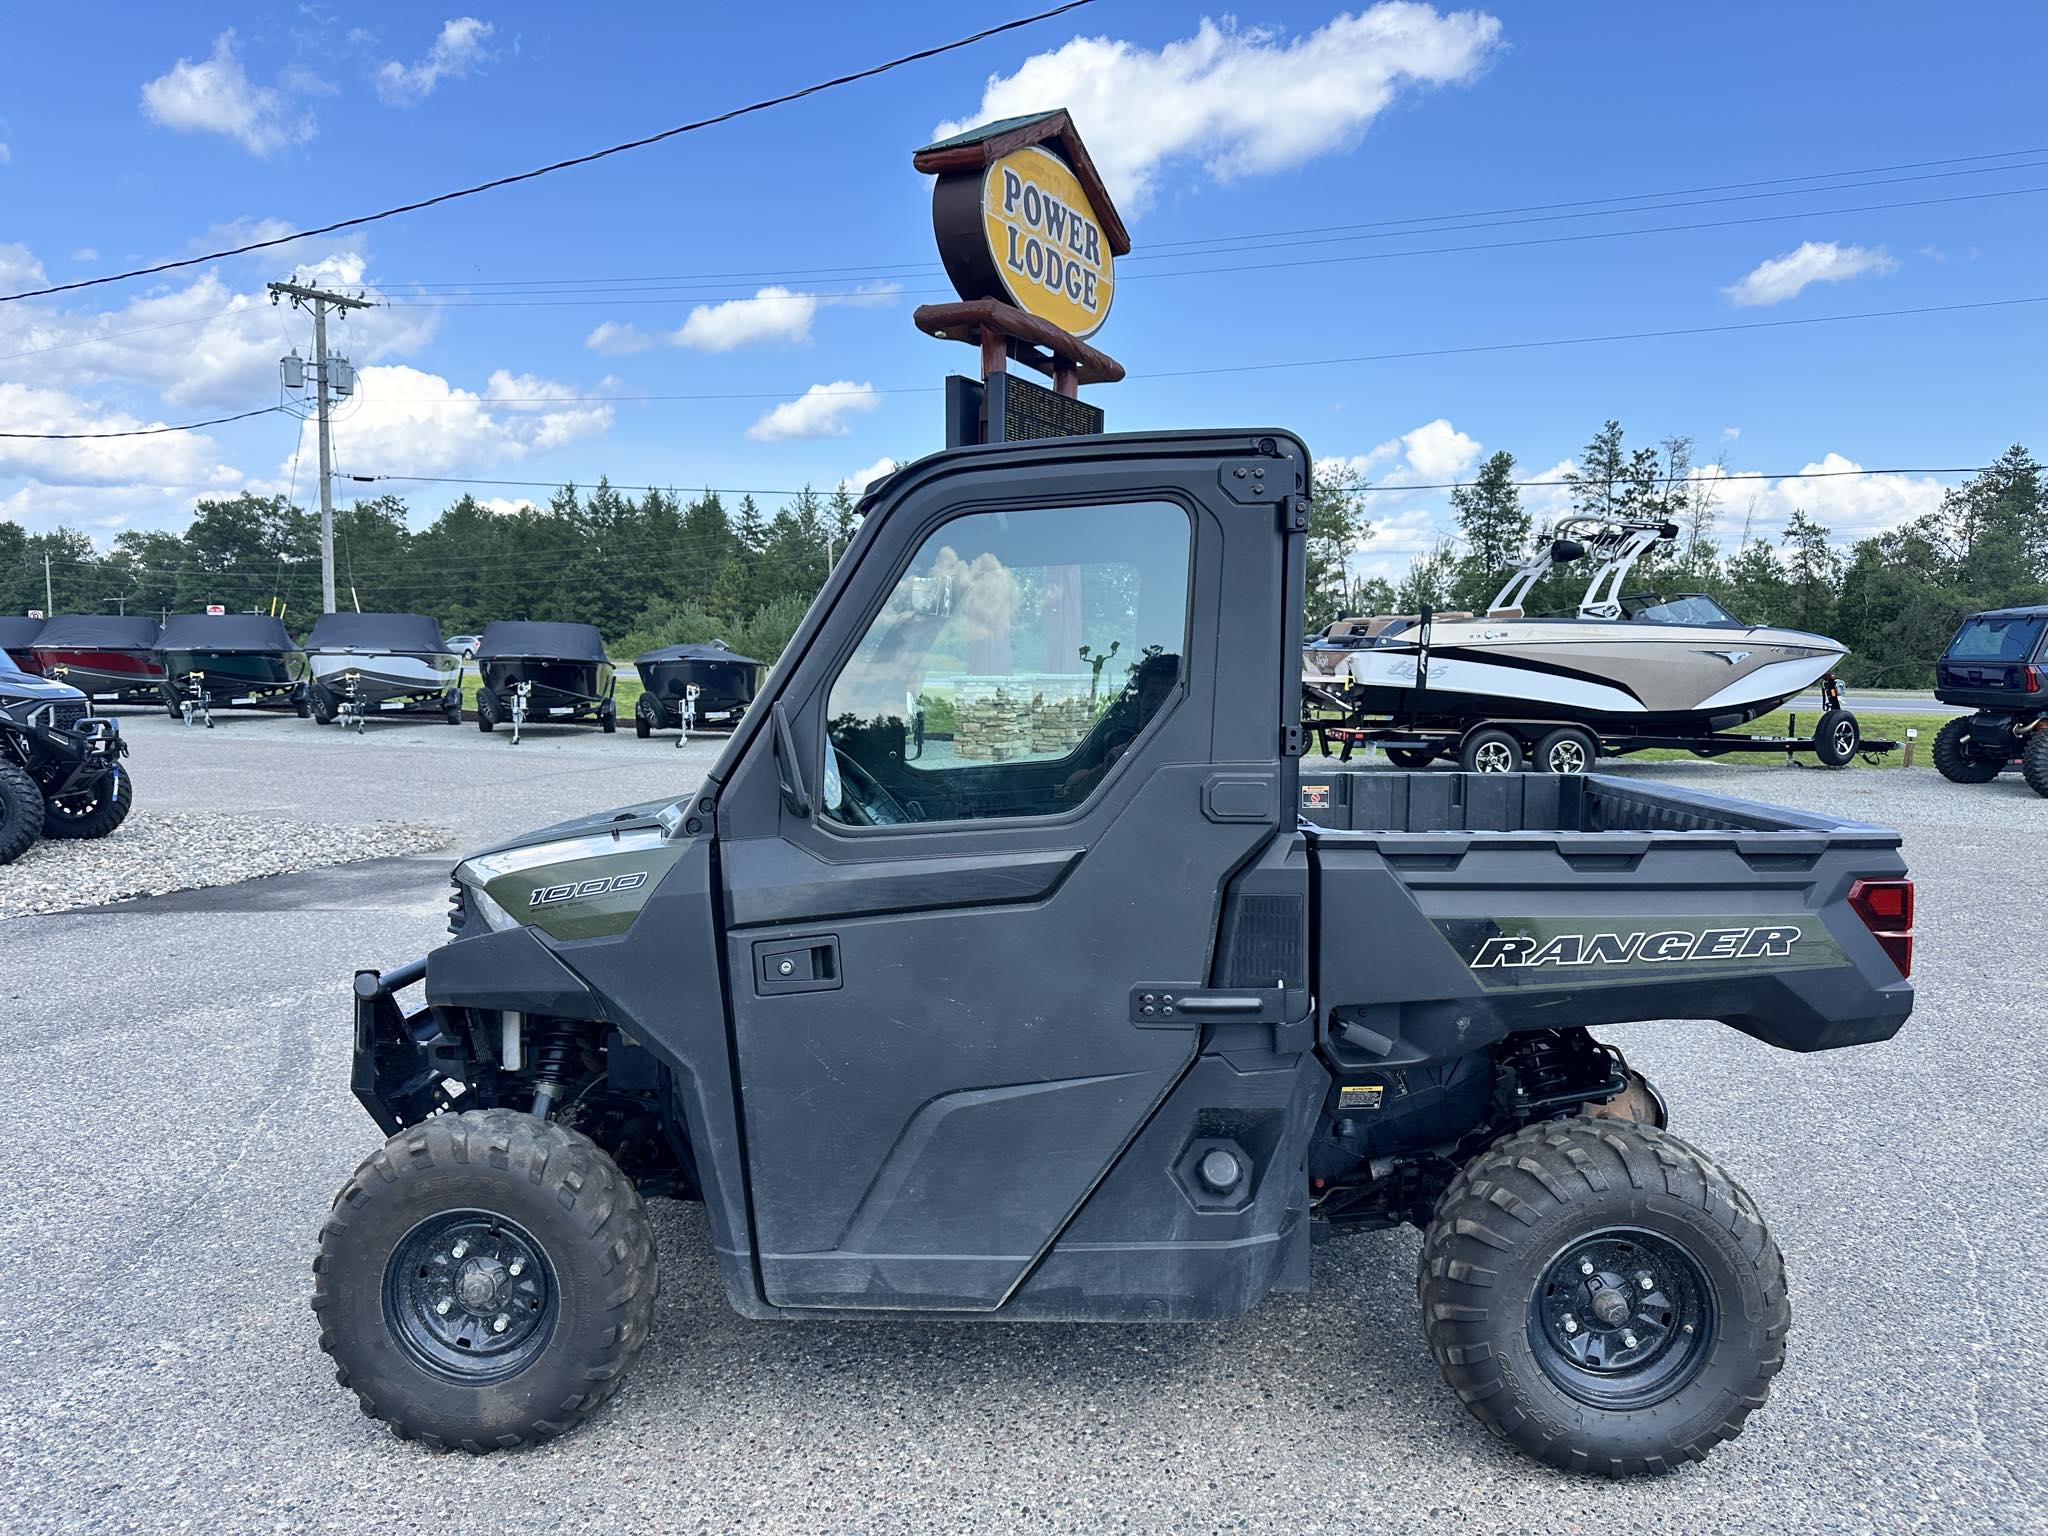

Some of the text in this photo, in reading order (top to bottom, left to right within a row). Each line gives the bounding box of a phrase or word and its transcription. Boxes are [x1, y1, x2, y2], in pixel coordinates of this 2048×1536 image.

[1001, 168, 1102, 267] POWER
[1006, 224, 1099, 313] LODGE
[529, 871, 648, 906] 1000
[1470, 926, 1801, 968] RANGER
[1681, 1208, 1755, 1286] CARLISLE
[1496, 1351, 1570, 1436] AT489
